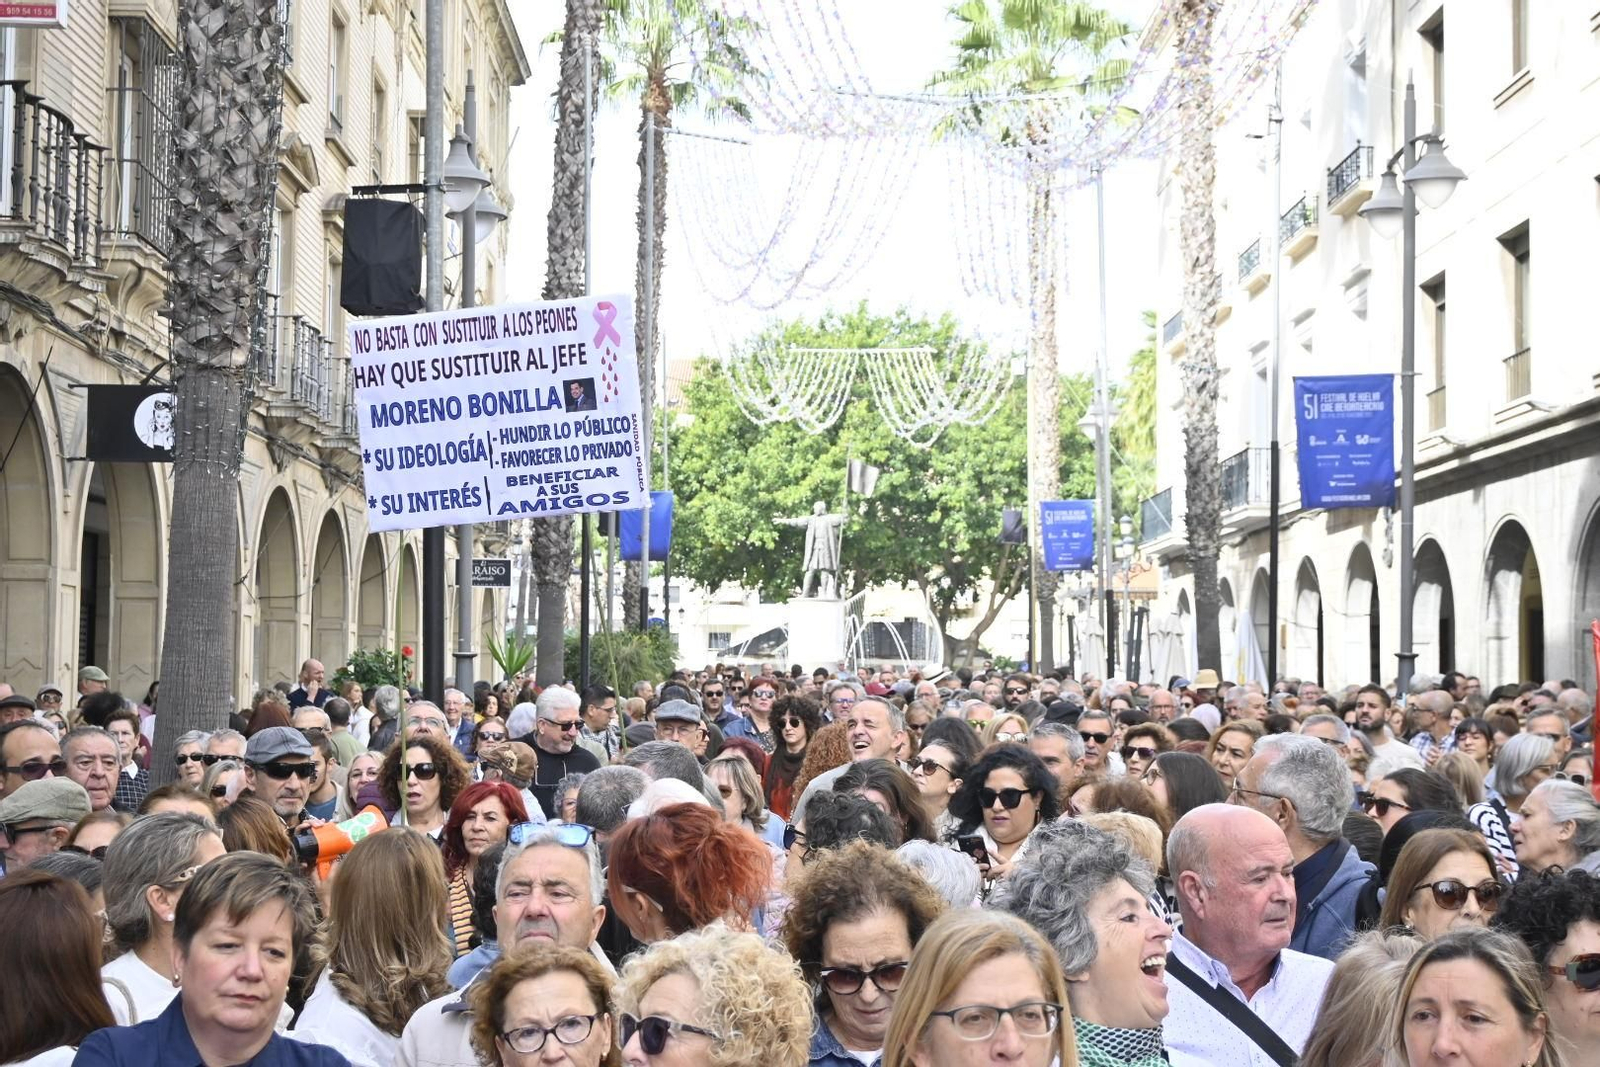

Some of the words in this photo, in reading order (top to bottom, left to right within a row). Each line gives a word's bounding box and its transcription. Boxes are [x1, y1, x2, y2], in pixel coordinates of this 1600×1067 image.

[354, 329, 370, 354] NO
[376, 325, 409, 352] BASTA
[414, 322, 438, 347] CON
[442, 316, 498, 344] SUSTITUIR
[504, 314, 511, 338] A
[512, 311, 532, 336] LOS
[535, 306, 578, 334] PEONES
[354, 364, 386, 388] HAY
[391, 360, 427, 388] QUE
[431, 350, 522, 380] SUSTITUIR
[526, 348, 548, 370] AL
[552, 343, 587, 374] JEFE
[370, 396, 462, 428] MORENO
[468, 386, 562, 418] BONILLA
[1304, 394, 1318, 419] 51
[500, 424, 552, 445] HUNDIR
[554, 422, 571, 440] LO
[574, 415, 631, 438] PÚBLICO
[374, 448, 394, 472] SU
[397, 433, 488, 470] IDEOLOGÍA
[501, 447, 562, 468] FAVORECER
[564, 445, 580, 462] LO
[582, 440, 632, 460] PRIVADO
[632, 414, 640, 452] SANIDAD
[636, 456, 644, 492] PÚBLICA
[506, 466, 620, 487] BENEFICIAR
[536, 486, 548, 497] A
[550, 483, 580, 496] SUS
[381, 494, 403, 515] SU
[407, 482, 482, 513] INTERÉS
[497, 491, 630, 515] AMIGOS
[472, 566, 506, 576] RAISO
